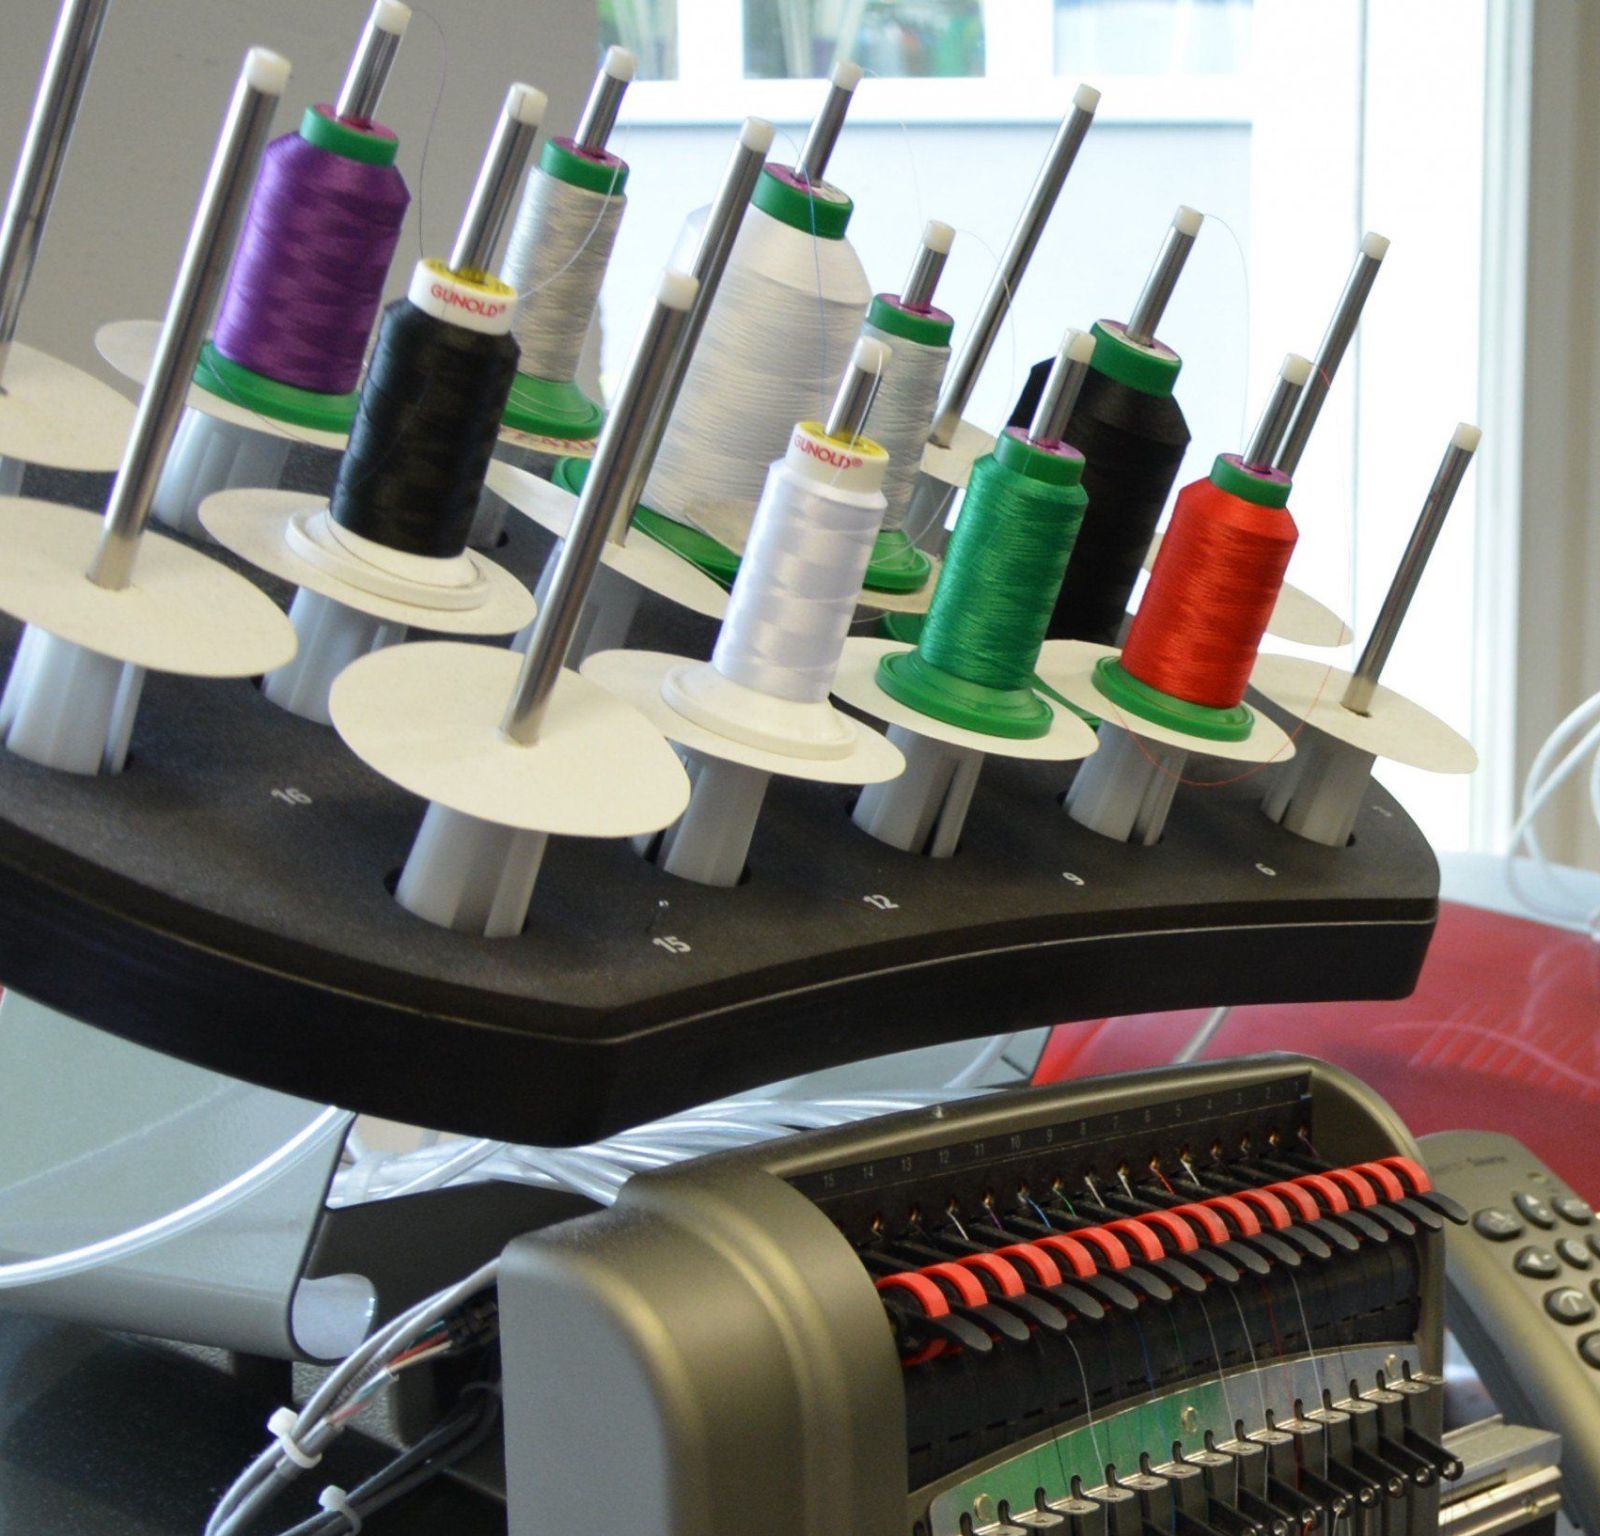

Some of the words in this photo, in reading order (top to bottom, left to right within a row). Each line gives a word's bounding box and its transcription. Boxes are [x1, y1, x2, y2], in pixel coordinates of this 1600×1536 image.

[271, 788, 312, 805] 16
[863, 894, 899, 910] 12
[652, 936, 691, 953] 15
